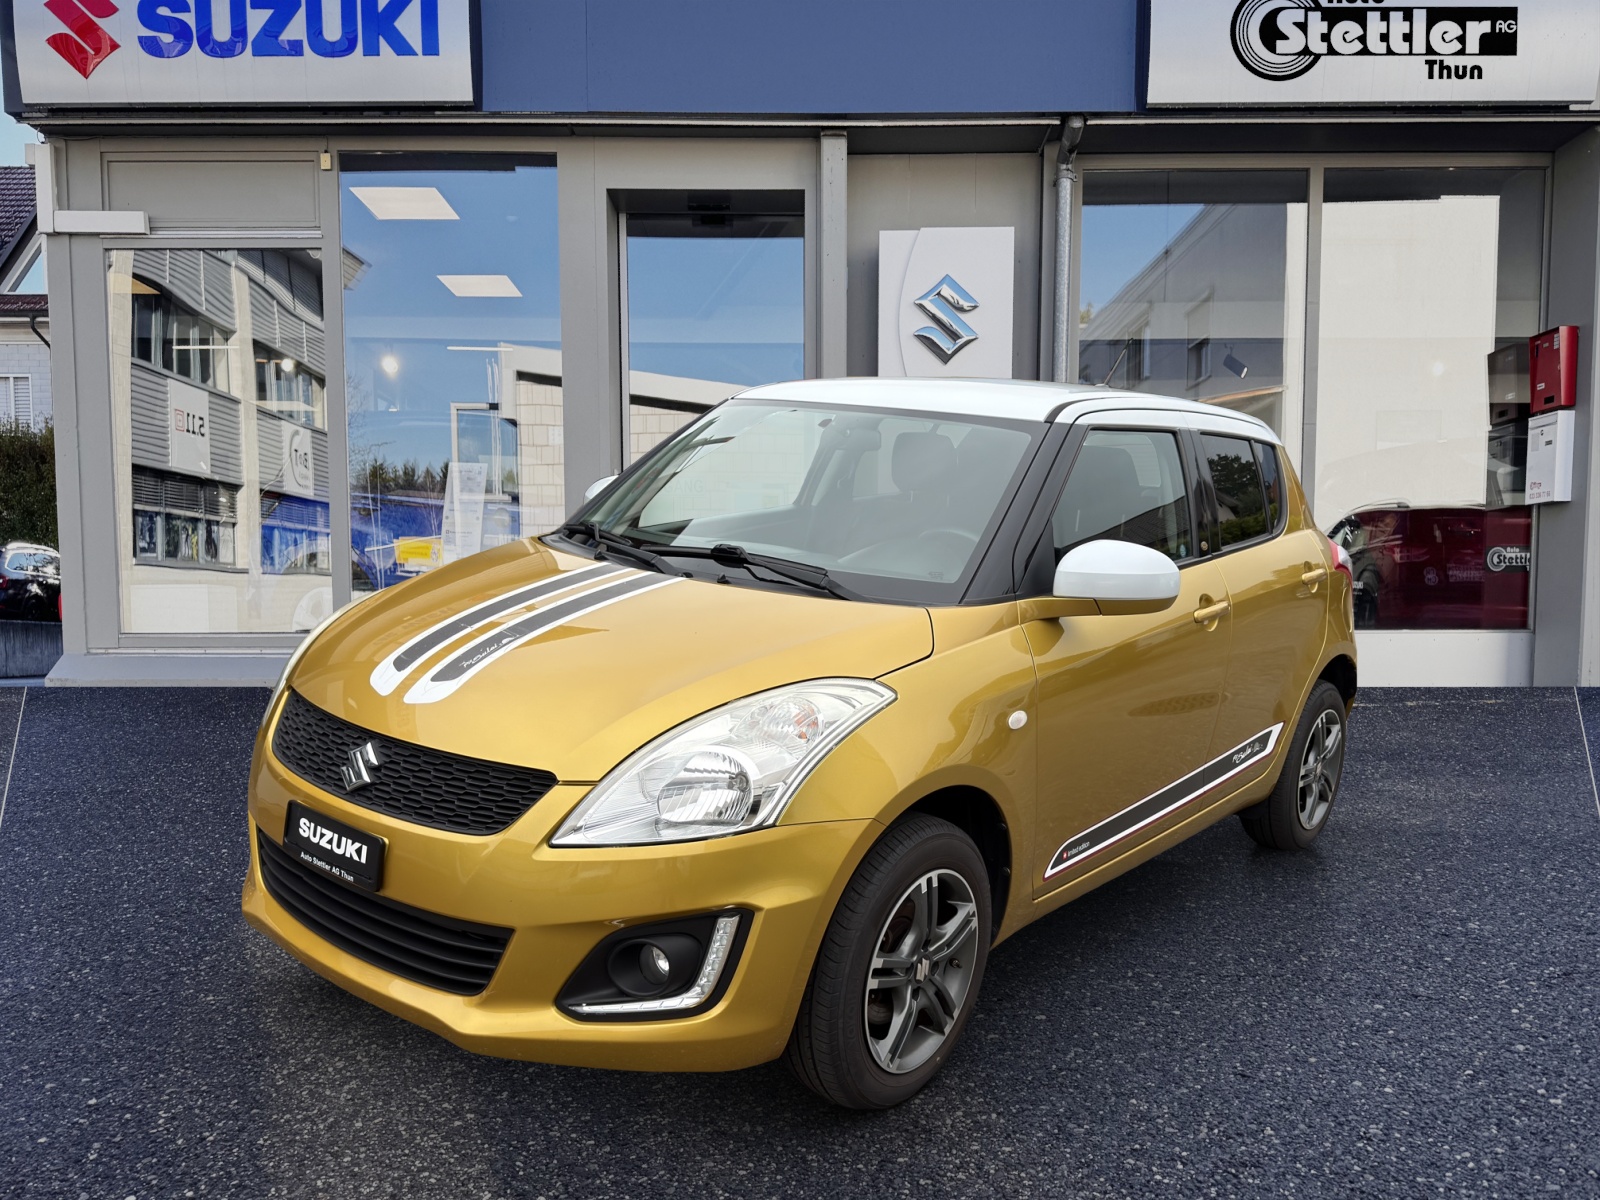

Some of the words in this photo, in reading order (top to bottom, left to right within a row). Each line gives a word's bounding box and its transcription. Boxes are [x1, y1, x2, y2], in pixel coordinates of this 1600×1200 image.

[137, 0, 440, 58] SUZUKI
[1276, 8, 1491, 55] Stettler
[1495, 20, 1517, 33] AG
[1425, 59, 1483, 80] Thun
[298, 817, 368, 864] SUZUKI
[300, 851, 312, 862] Auto
[313, 857, 331, 871] Stettler
[331, 866, 340, 875] AG
[341, 869, 354, 882] Thun
